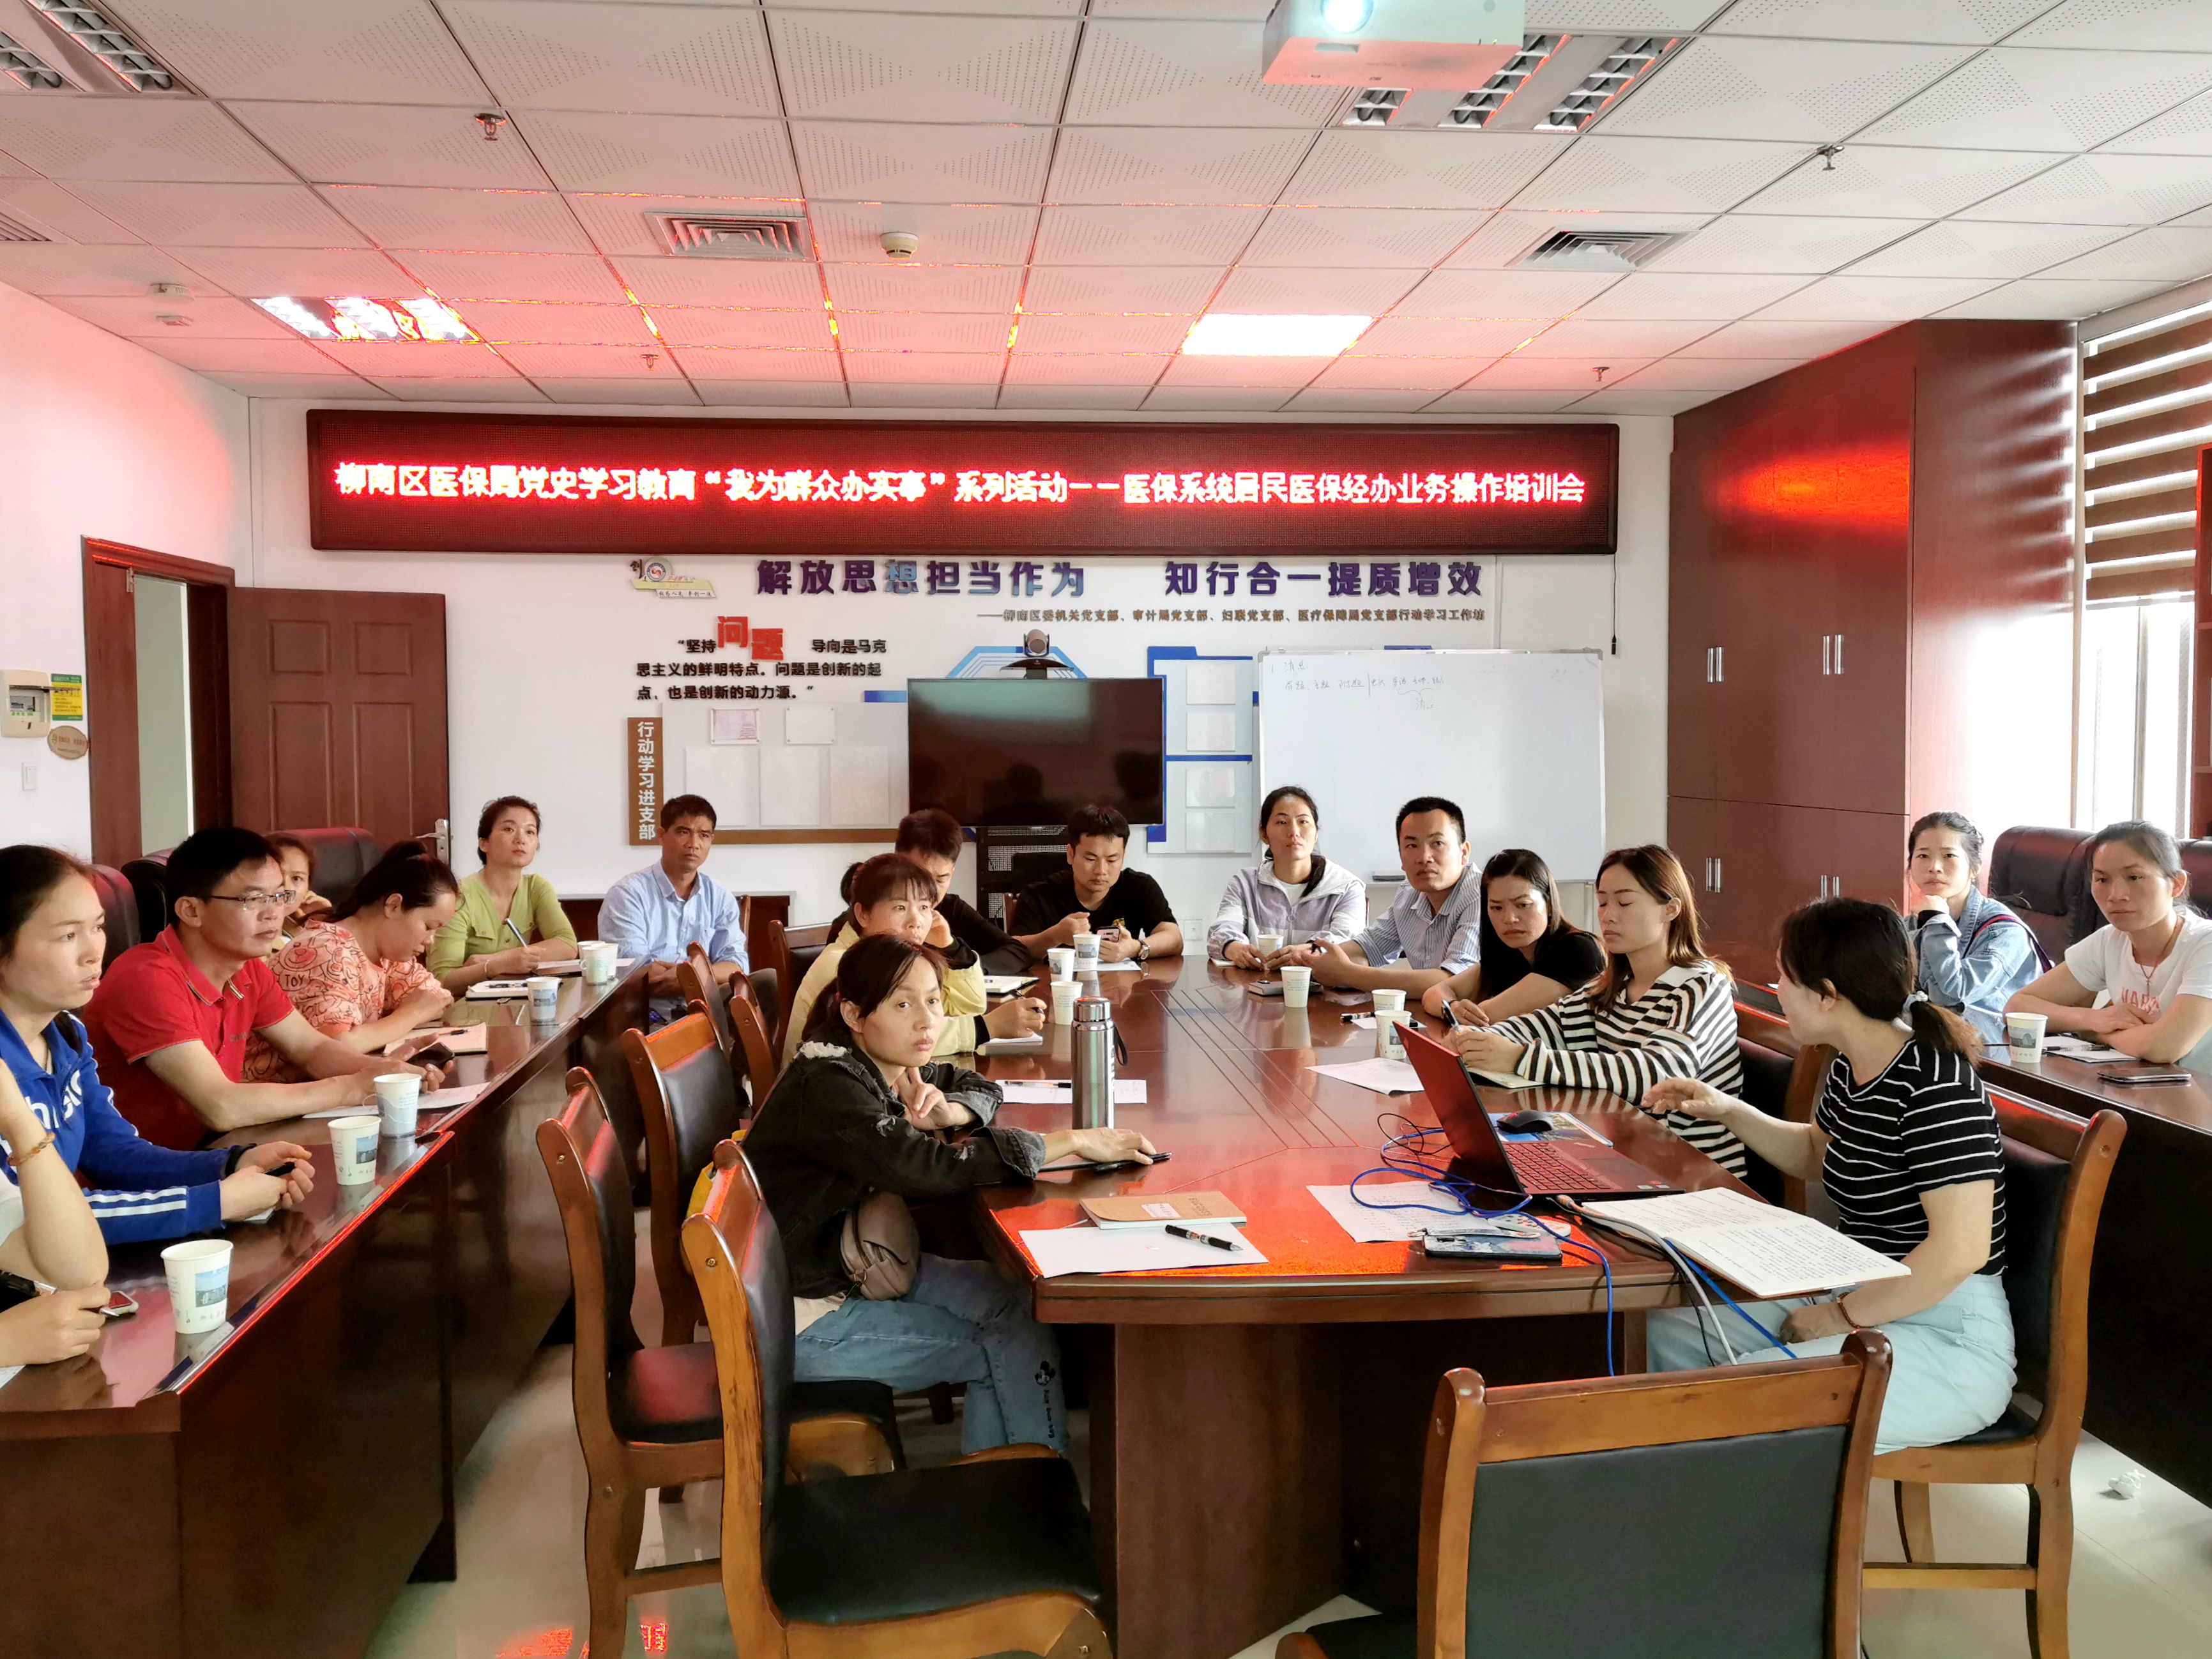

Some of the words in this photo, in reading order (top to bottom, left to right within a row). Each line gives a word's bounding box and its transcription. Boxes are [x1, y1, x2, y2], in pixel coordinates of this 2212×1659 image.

[758, 559, 1085, 597] 解放思想担当作为
[1165, 561, 1482, 597] 知行合一提质增效
[717, 616, 784, 661] 问题
[812, 639, 887, 654] 导向是马克
[637, 721, 657, 840] 行动学习进支部
